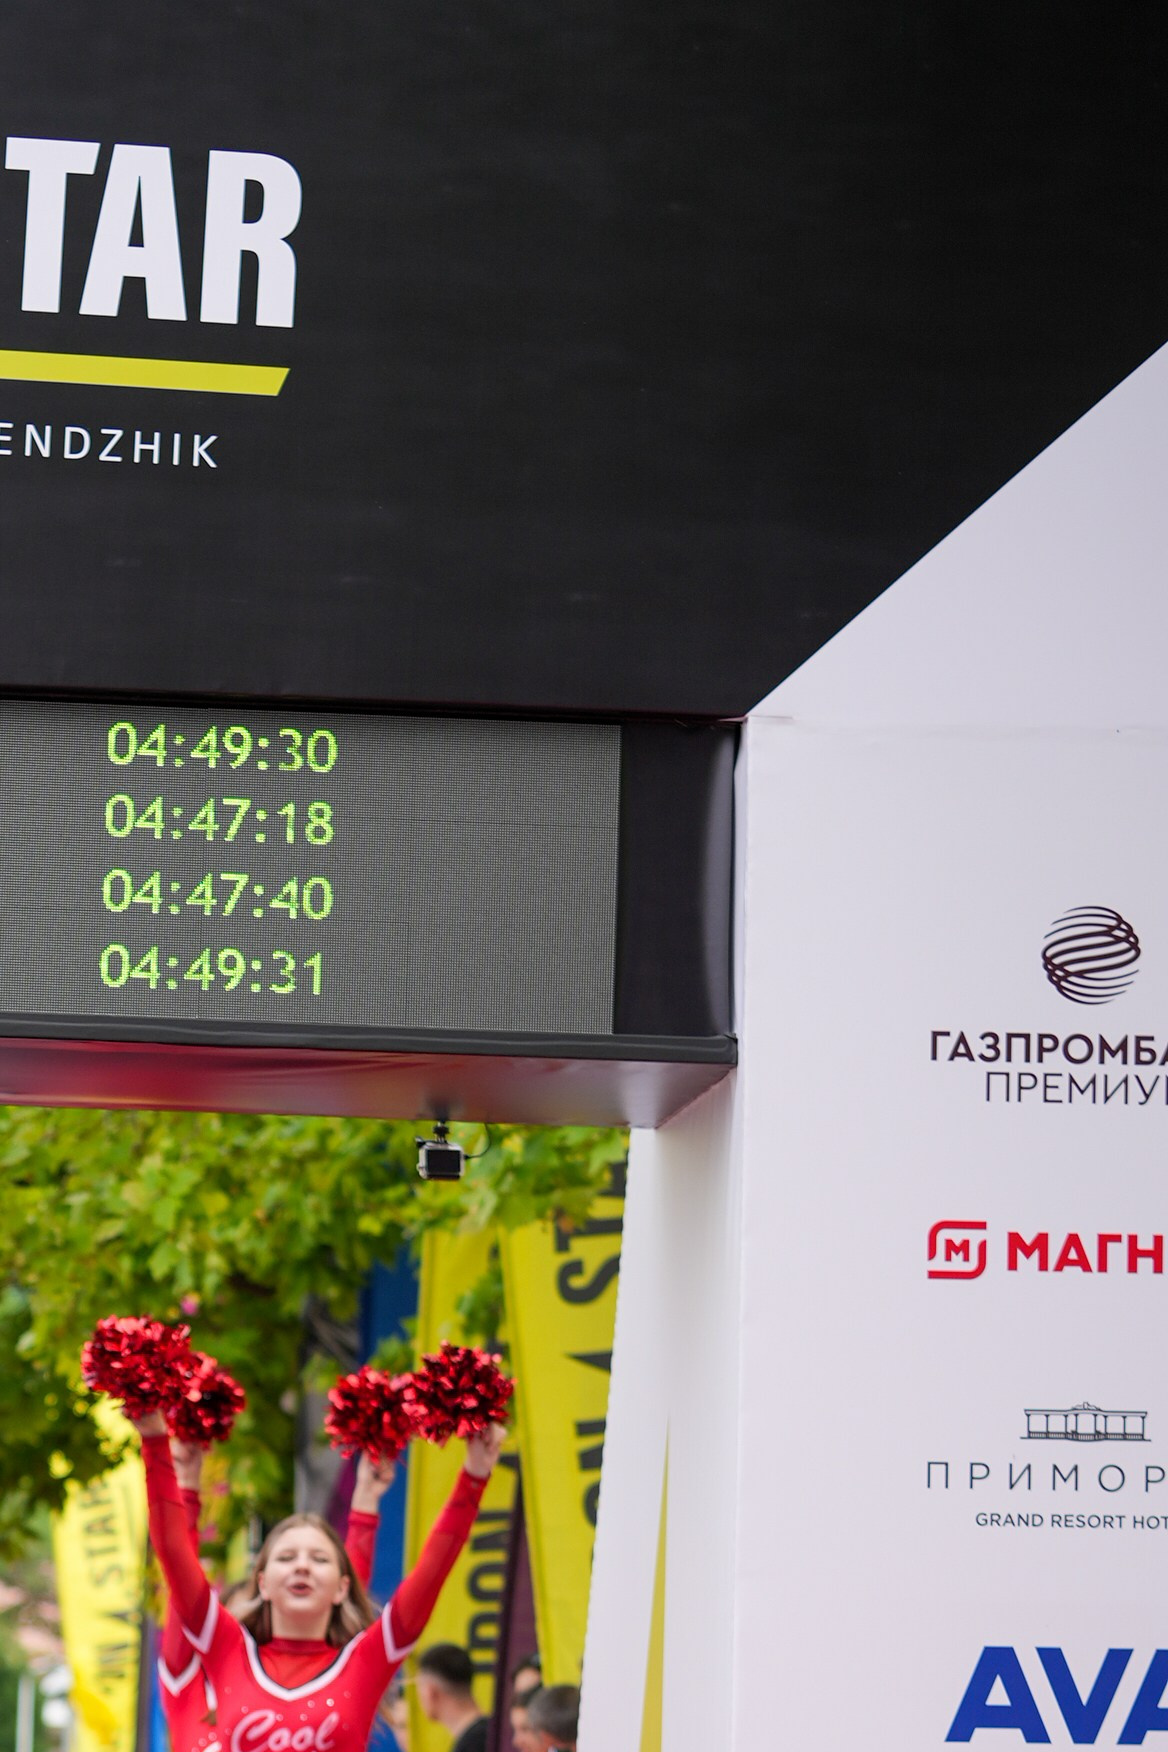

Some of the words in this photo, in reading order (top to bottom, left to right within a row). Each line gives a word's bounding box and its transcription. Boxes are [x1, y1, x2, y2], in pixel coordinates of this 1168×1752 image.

[107, 721, 338, 772] 04:49:30
[105, 793, 335, 845] 04:47:18
[102, 868, 334, 920] 04:47:40
[99, 943, 322, 994] 04:49:31
[986, 1071, 1168, 1106] ПРЕМИУ
[927, 1462, 1166, 1493] ПРИМОР
[975, 1512, 1044, 1527] GRAND
[1051, 1514, 1126, 1529] RESORT
